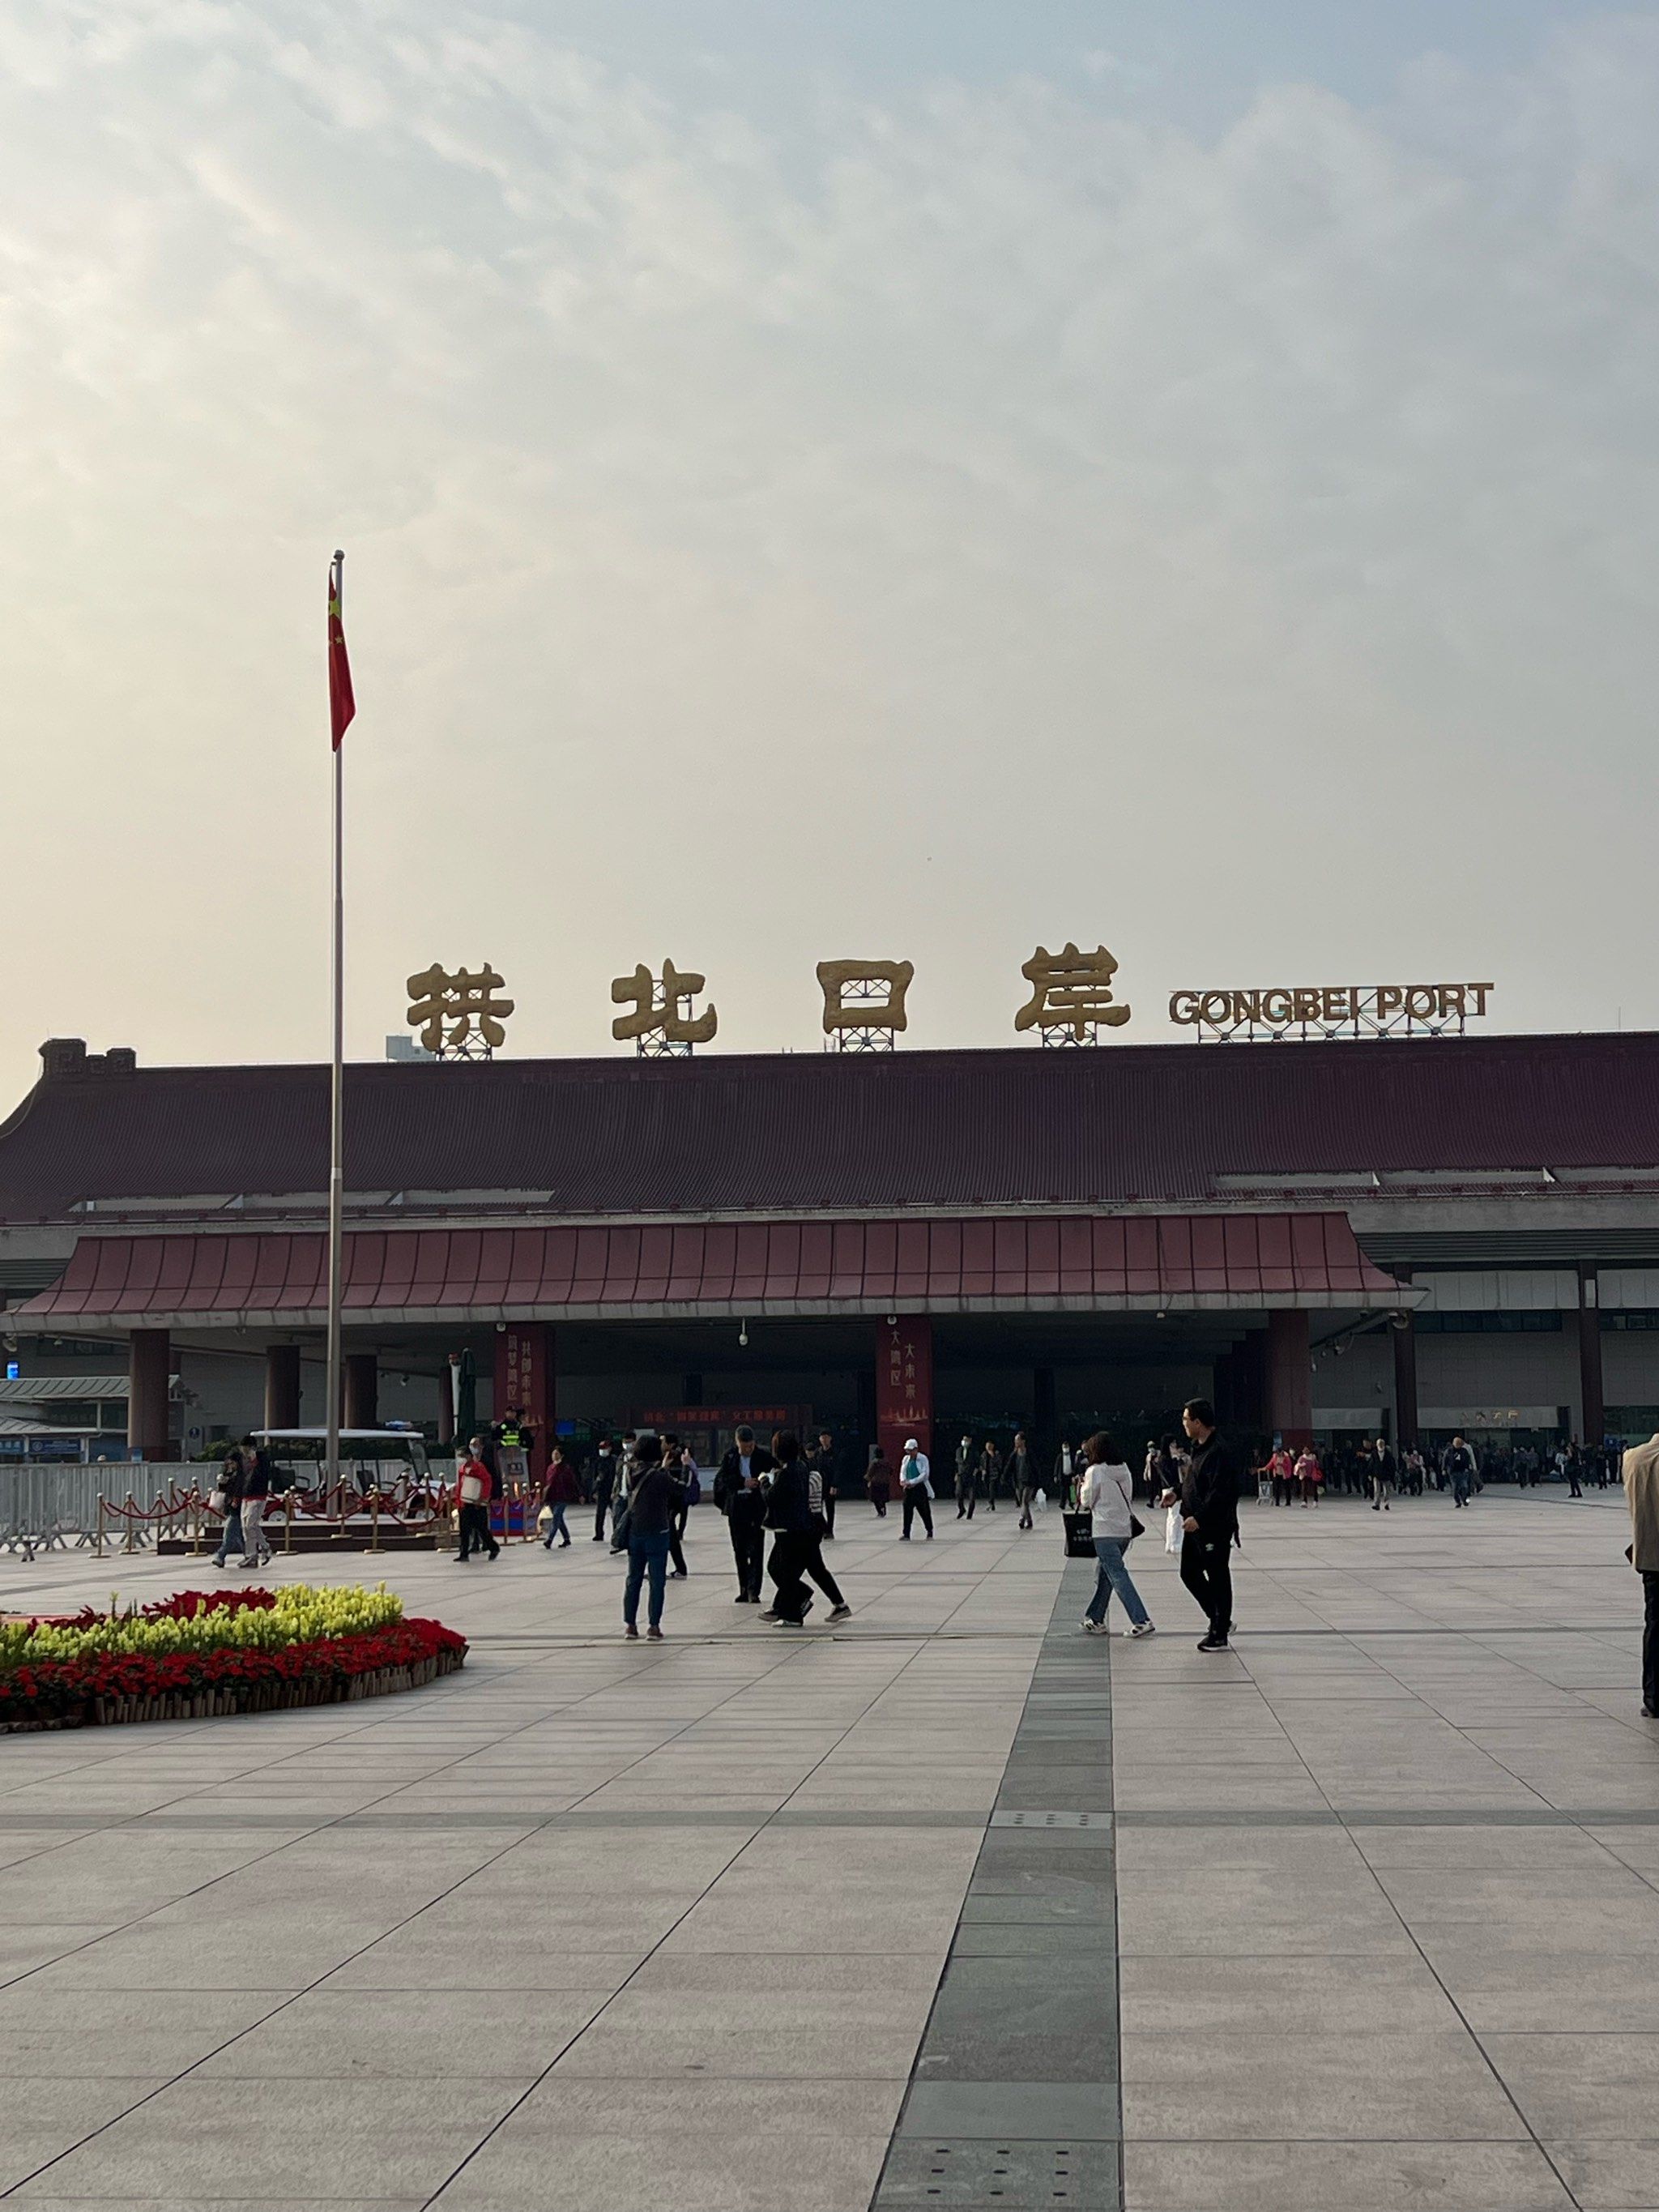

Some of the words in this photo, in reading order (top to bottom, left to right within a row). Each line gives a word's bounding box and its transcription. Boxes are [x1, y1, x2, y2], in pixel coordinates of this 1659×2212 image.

[406, 942, 1131, 1051] 拱北口岸
[1169, 986, 1359, 1024] GONGBEI
[1377, 982, 1494, 1019] PORT
